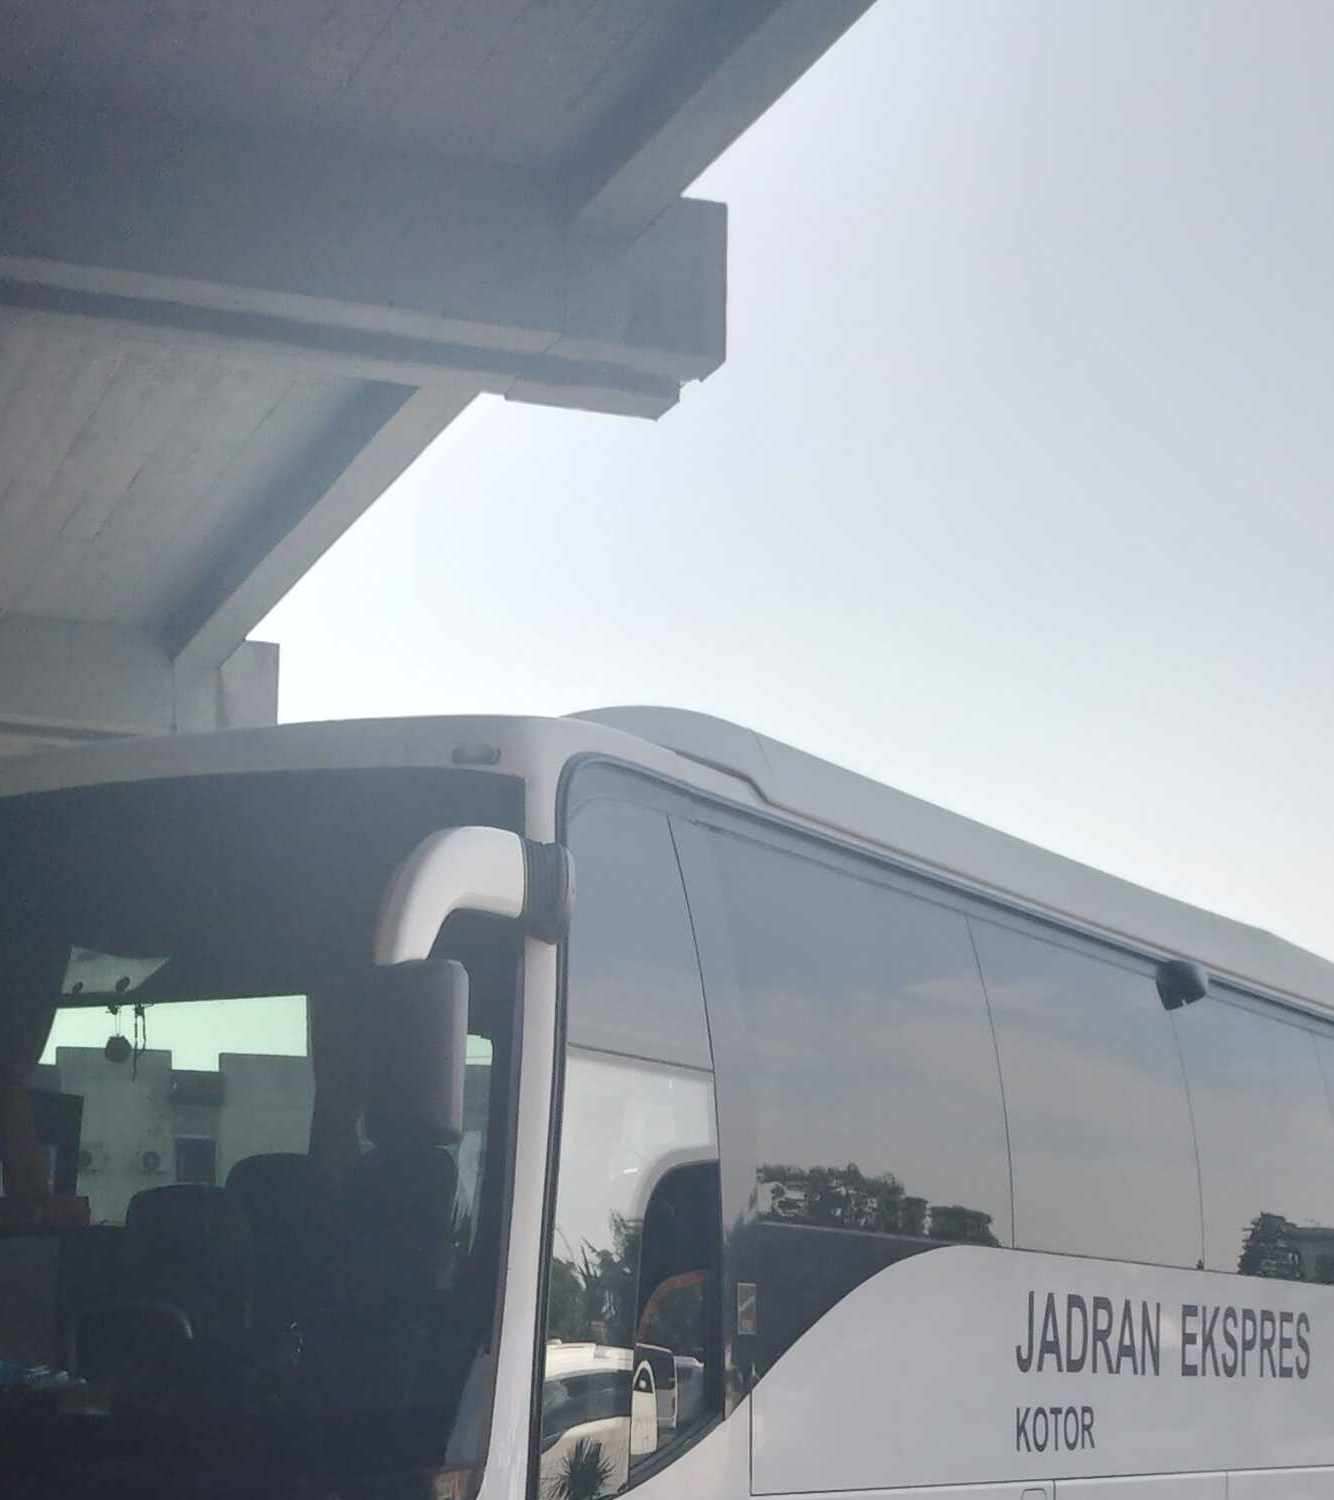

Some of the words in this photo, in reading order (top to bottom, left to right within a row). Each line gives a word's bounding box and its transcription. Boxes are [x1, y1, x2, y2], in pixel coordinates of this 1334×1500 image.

[1015, 1290, 1161, 1377] JADRAN
[1180, 1304, 1311, 1380] EKSPRES
[1016, 1405, 1096, 1453] KOTOR
